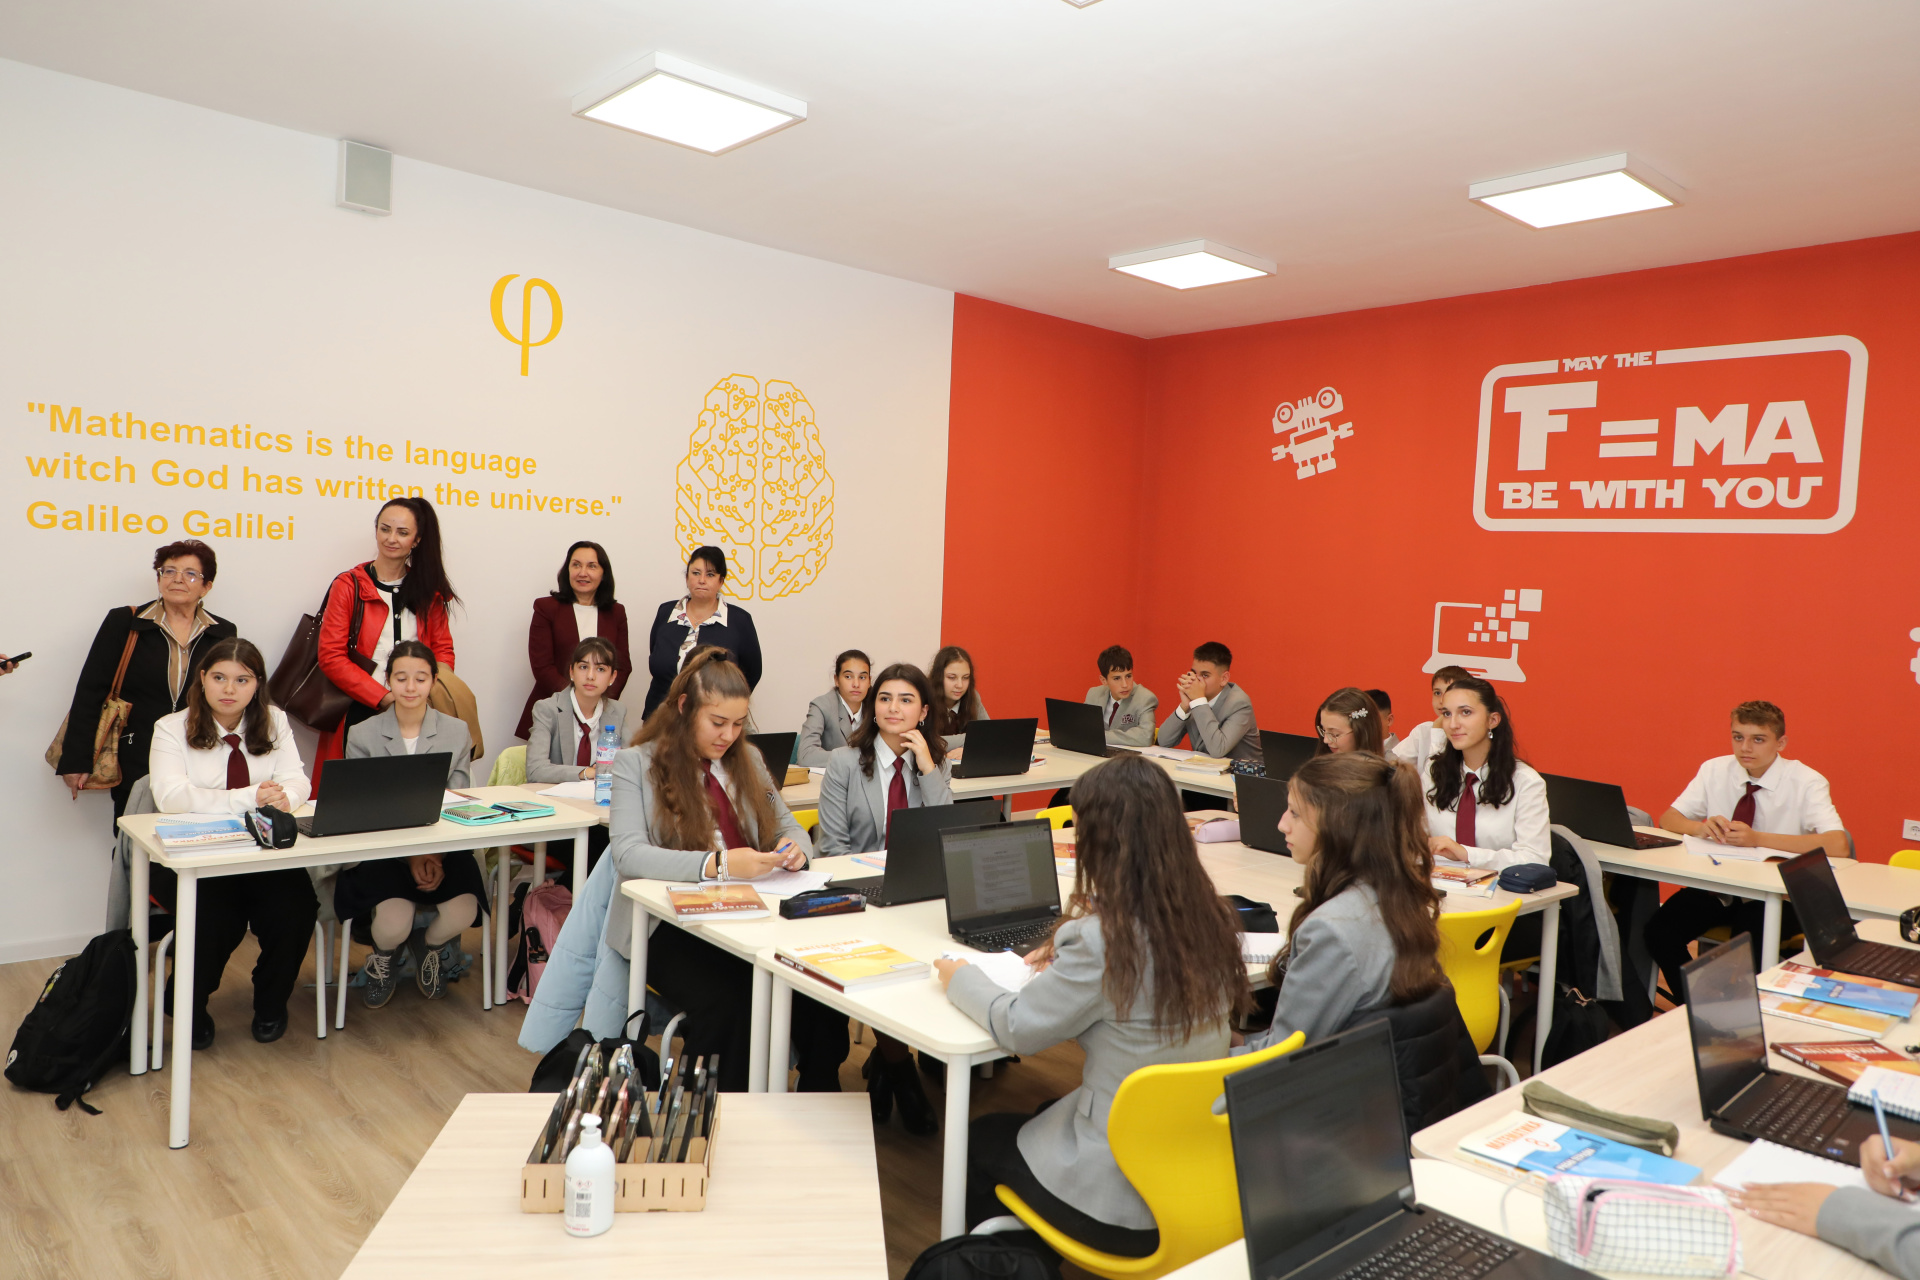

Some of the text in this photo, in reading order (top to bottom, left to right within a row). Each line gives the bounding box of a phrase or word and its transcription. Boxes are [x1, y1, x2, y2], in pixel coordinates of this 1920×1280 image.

[1562, 351, 1653, 372] MAY THE
[27, 401, 537, 479] "Mathematics is the language
[25, 452, 136, 484] witch
[151, 459, 228, 490] God
[243, 466, 303, 495] has
[435, 482, 480, 507] the
[490, 489, 622, 516] universe."
[1499, 476, 1823, 509] BE WITH YOU
[26, 501, 294, 541] Galileo Galilei
[1485, 1120, 1542, 1150] МАТЕМАТИКА
